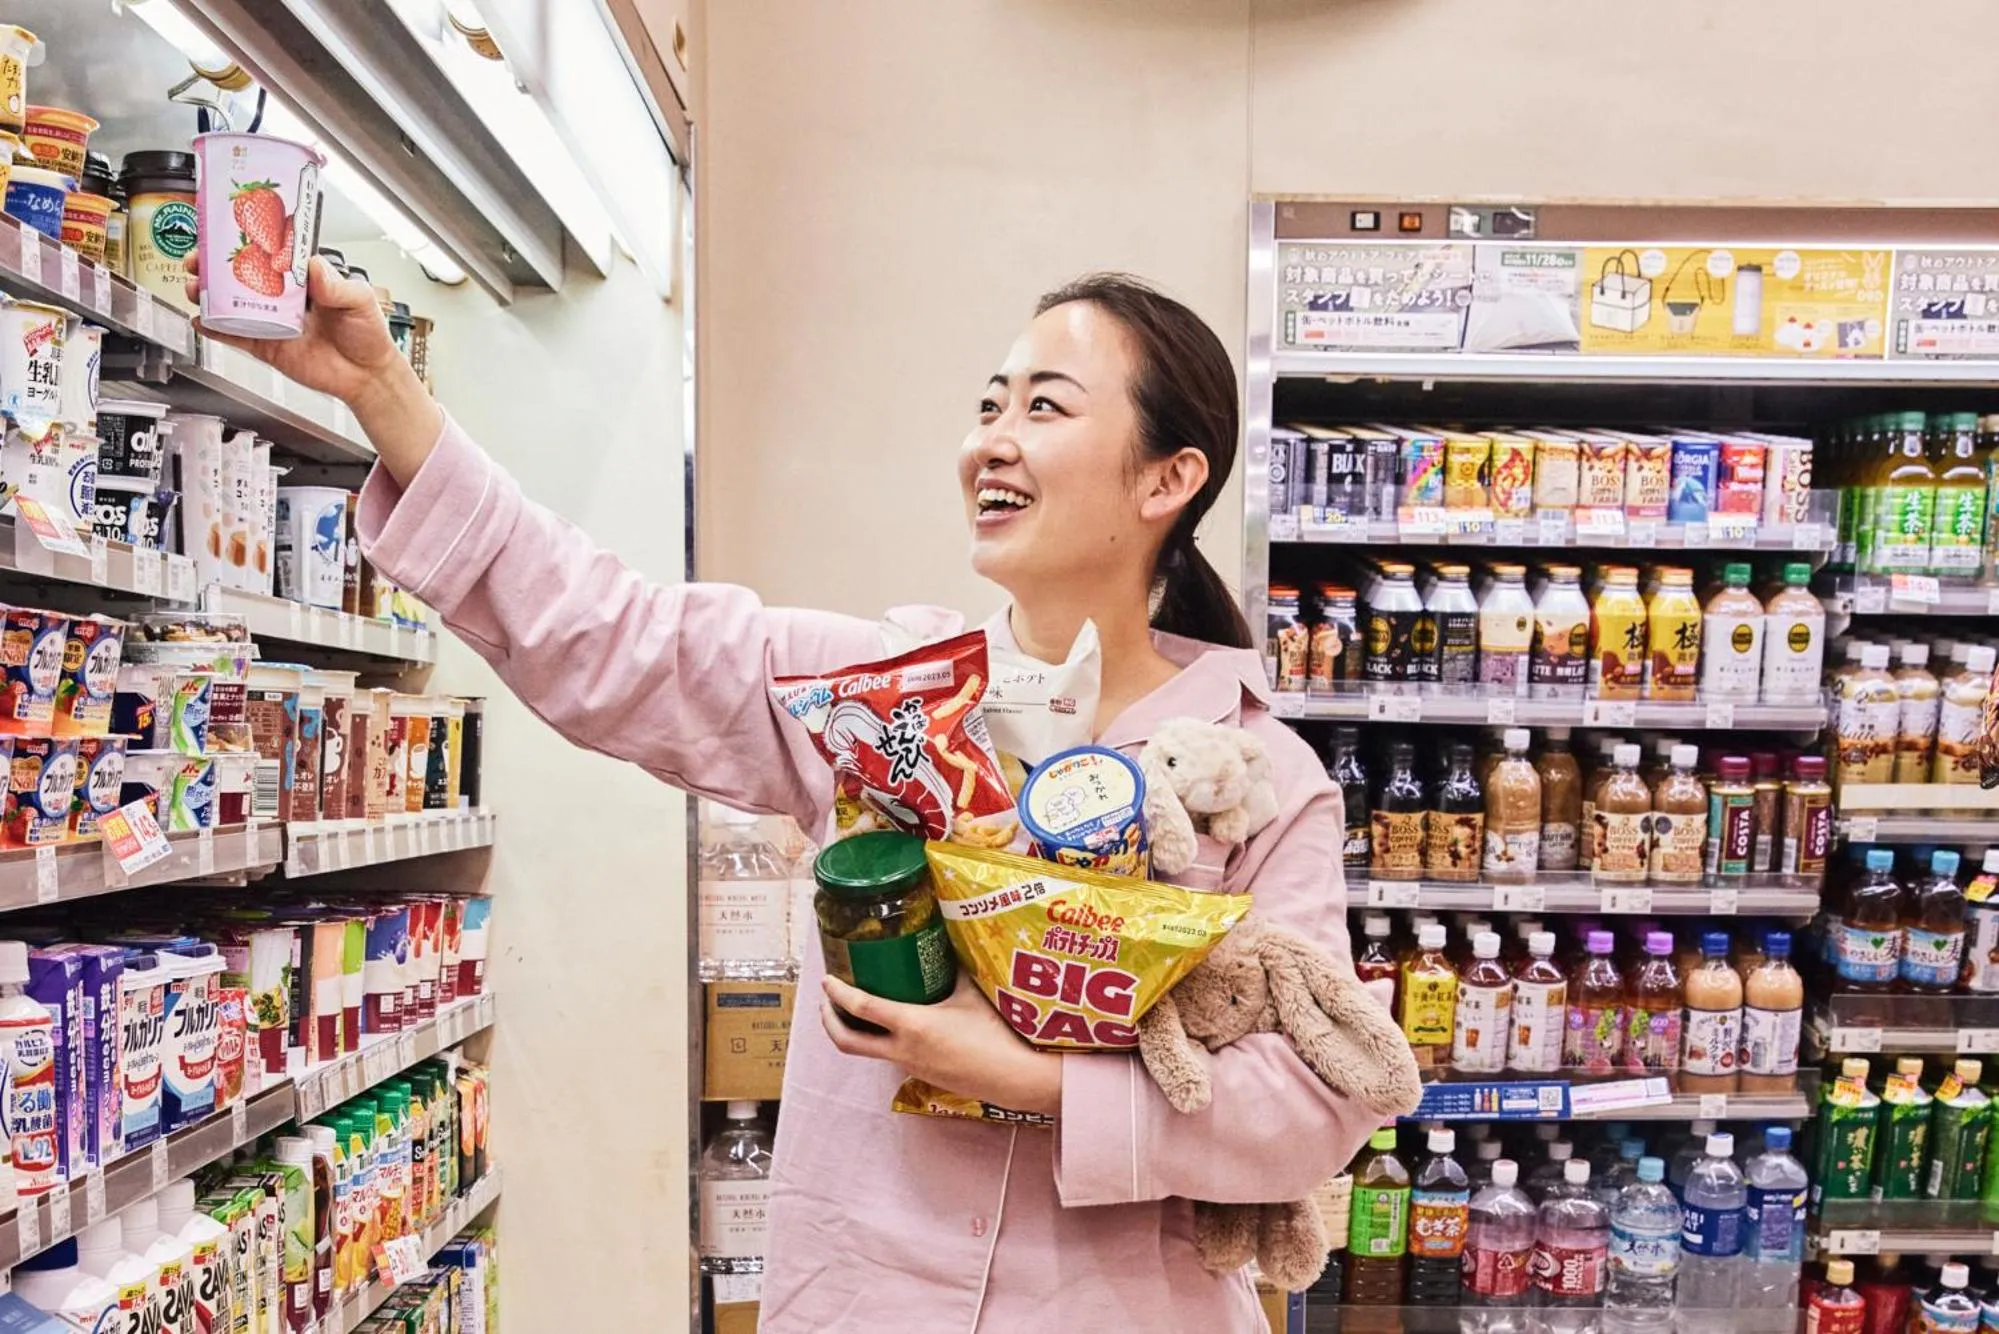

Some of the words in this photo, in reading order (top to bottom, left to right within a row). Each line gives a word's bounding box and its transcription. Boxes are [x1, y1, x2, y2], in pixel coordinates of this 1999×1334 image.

[838, 674, 892, 697] Calbee
[1046, 899, 1126, 932] Calbee
[1042, 927, 1120, 962] ポテトチップス
[1011, 949, 1140, 1017] BIG
[1415, 1217, 1460, 1237] むぎ茶
